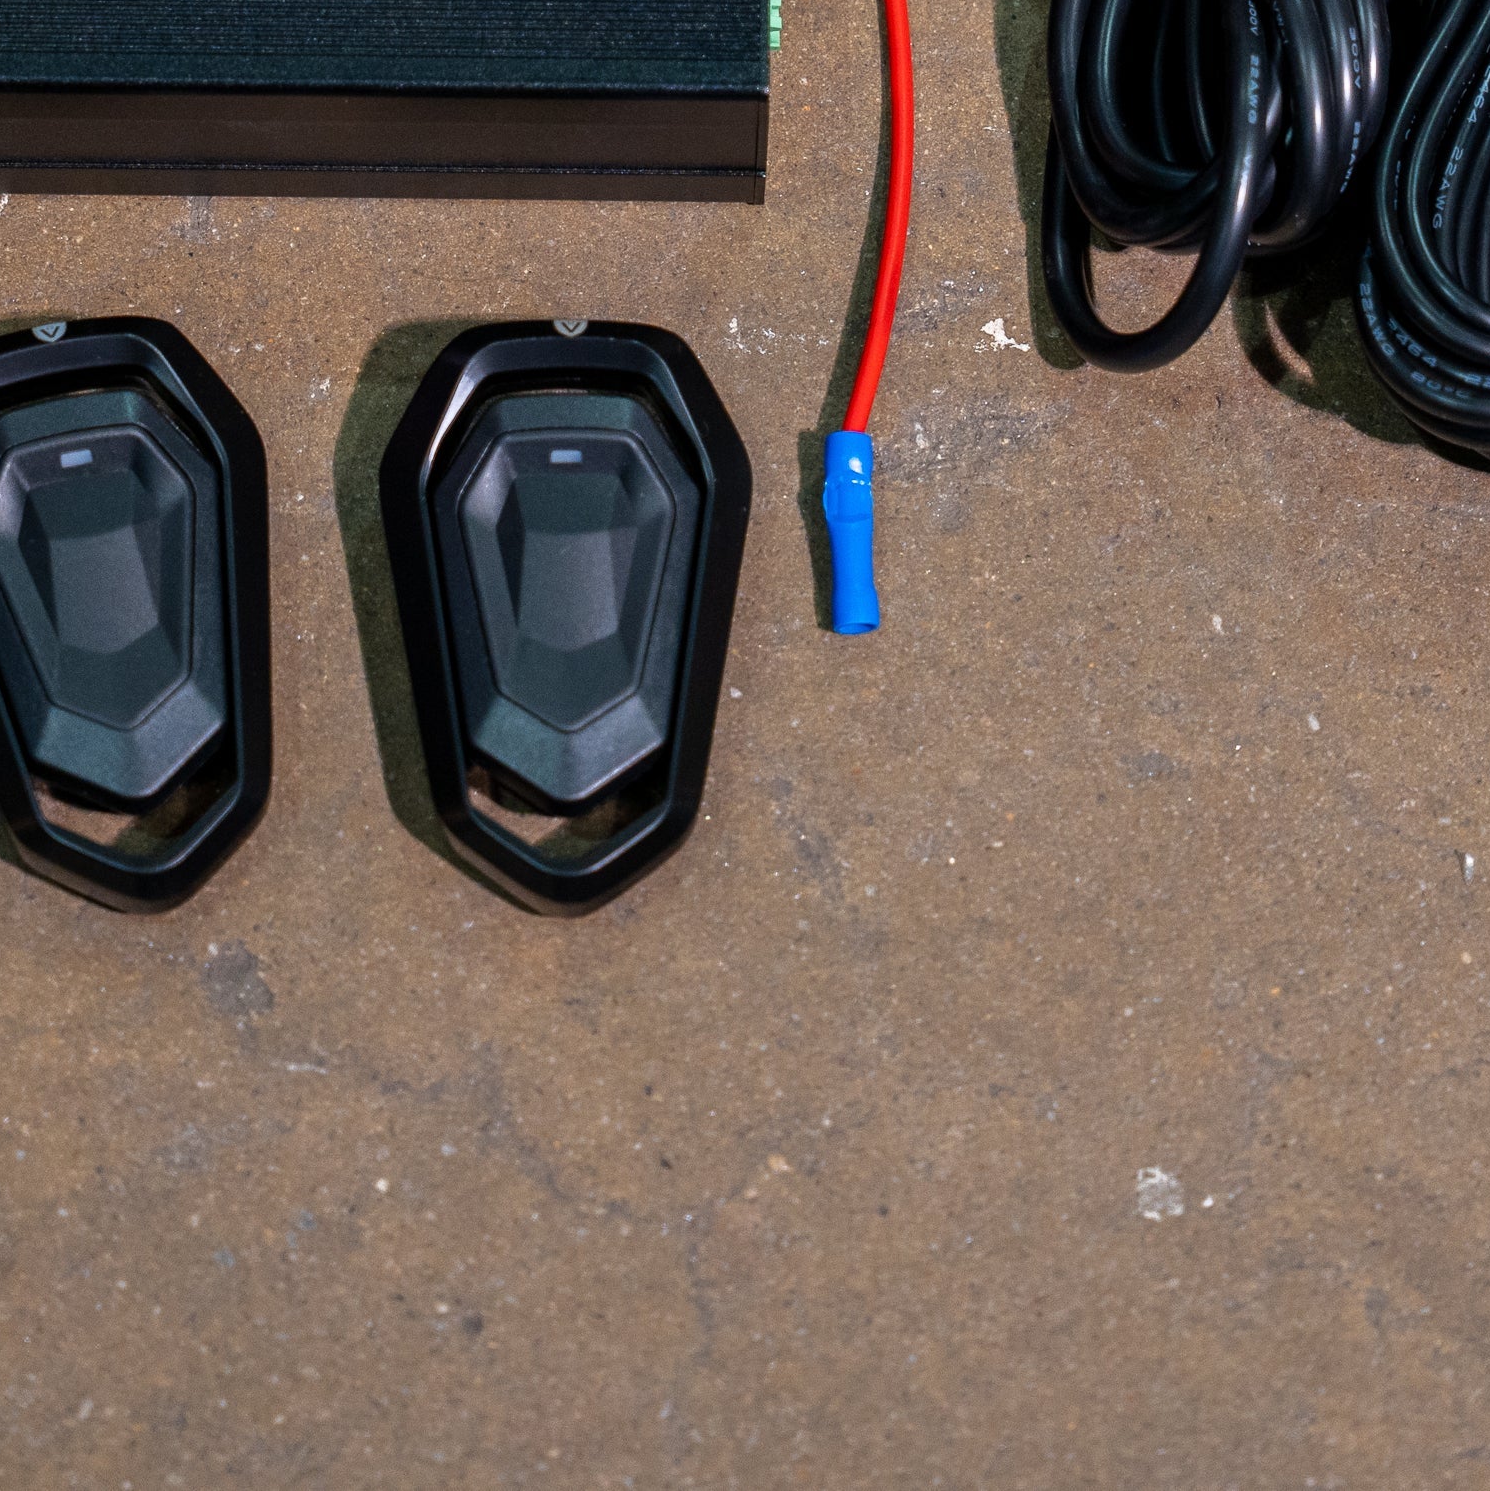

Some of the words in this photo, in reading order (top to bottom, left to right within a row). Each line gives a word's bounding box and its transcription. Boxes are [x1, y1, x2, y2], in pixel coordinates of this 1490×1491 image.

[1247, 55, 1260, 125] 22AWG
[1348, 26, 1362, 90] 300V
[1340, 120, 1362, 194] 22AWG
[1432, 145, 1464, 229] 22AWG
[1359, 282, 1396, 358] 22AWG
